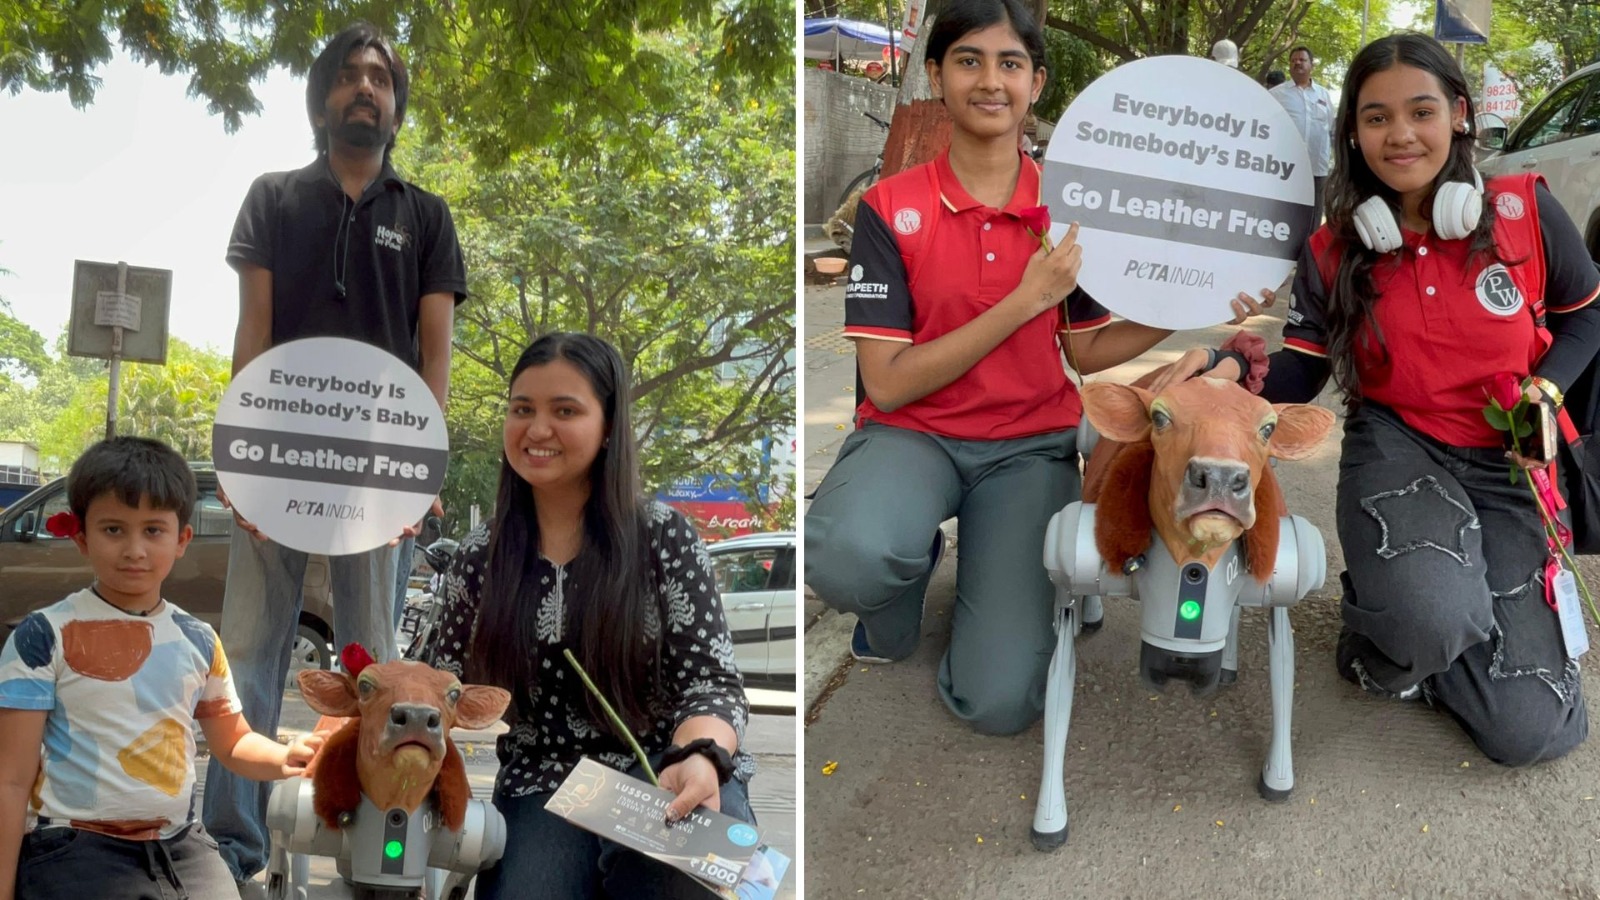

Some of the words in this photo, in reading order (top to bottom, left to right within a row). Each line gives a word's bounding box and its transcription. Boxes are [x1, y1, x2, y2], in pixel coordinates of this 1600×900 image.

[1112, 93, 1245, 137] Everybody
[1251, 119, 1270, 140] Is
[1486, 100, 1517, 112] 84120
[1075, 121, 1229, 166] Somebody's
[1234, 149, 1295, 181] Baby
[1062, 182, 1102, 207] Go
[1109, 189, 1222, 230] Leather
[1228, 209, 1290, 242] Free
[377, 225, 403, 244] Hope
[269, 369, 383, 399] Everybody
[388, 383, 406, 399] Is
[239, 392, 371, 422] Somebody's
[376, 408, 429, 431] Baby
[229, 439, 264, 461] Go
[270, 444, 368, 473] Leather
[373, 455, 429, 480] Free
[1227, 555, 1238, 585] 02
[615, 781, 652, 802] LUSSO
